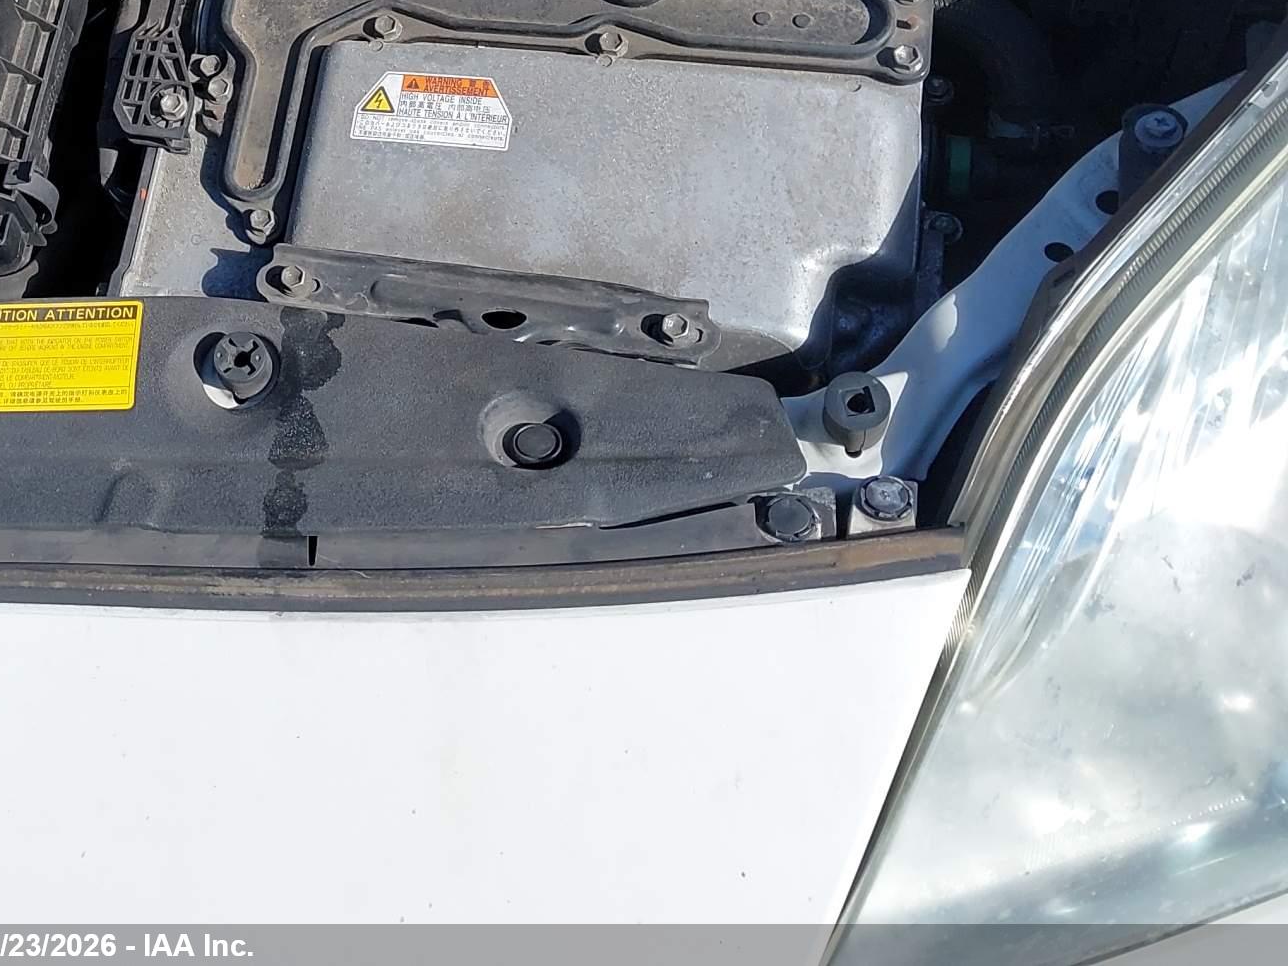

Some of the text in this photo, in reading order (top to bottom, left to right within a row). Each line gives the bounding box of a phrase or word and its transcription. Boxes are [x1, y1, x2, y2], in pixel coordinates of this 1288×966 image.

[425, 76, 462, 88] WARNING
[424, 83, 490, 96] AVERTISSEMENT
[400, 93, 483, 105] HIGH VOLTAGE INSIDE
[398, 108, 421, 117] HAUTE
[424, 110, 454, 119] TENSION
[44, 306, 134, 321] ATTENTION
